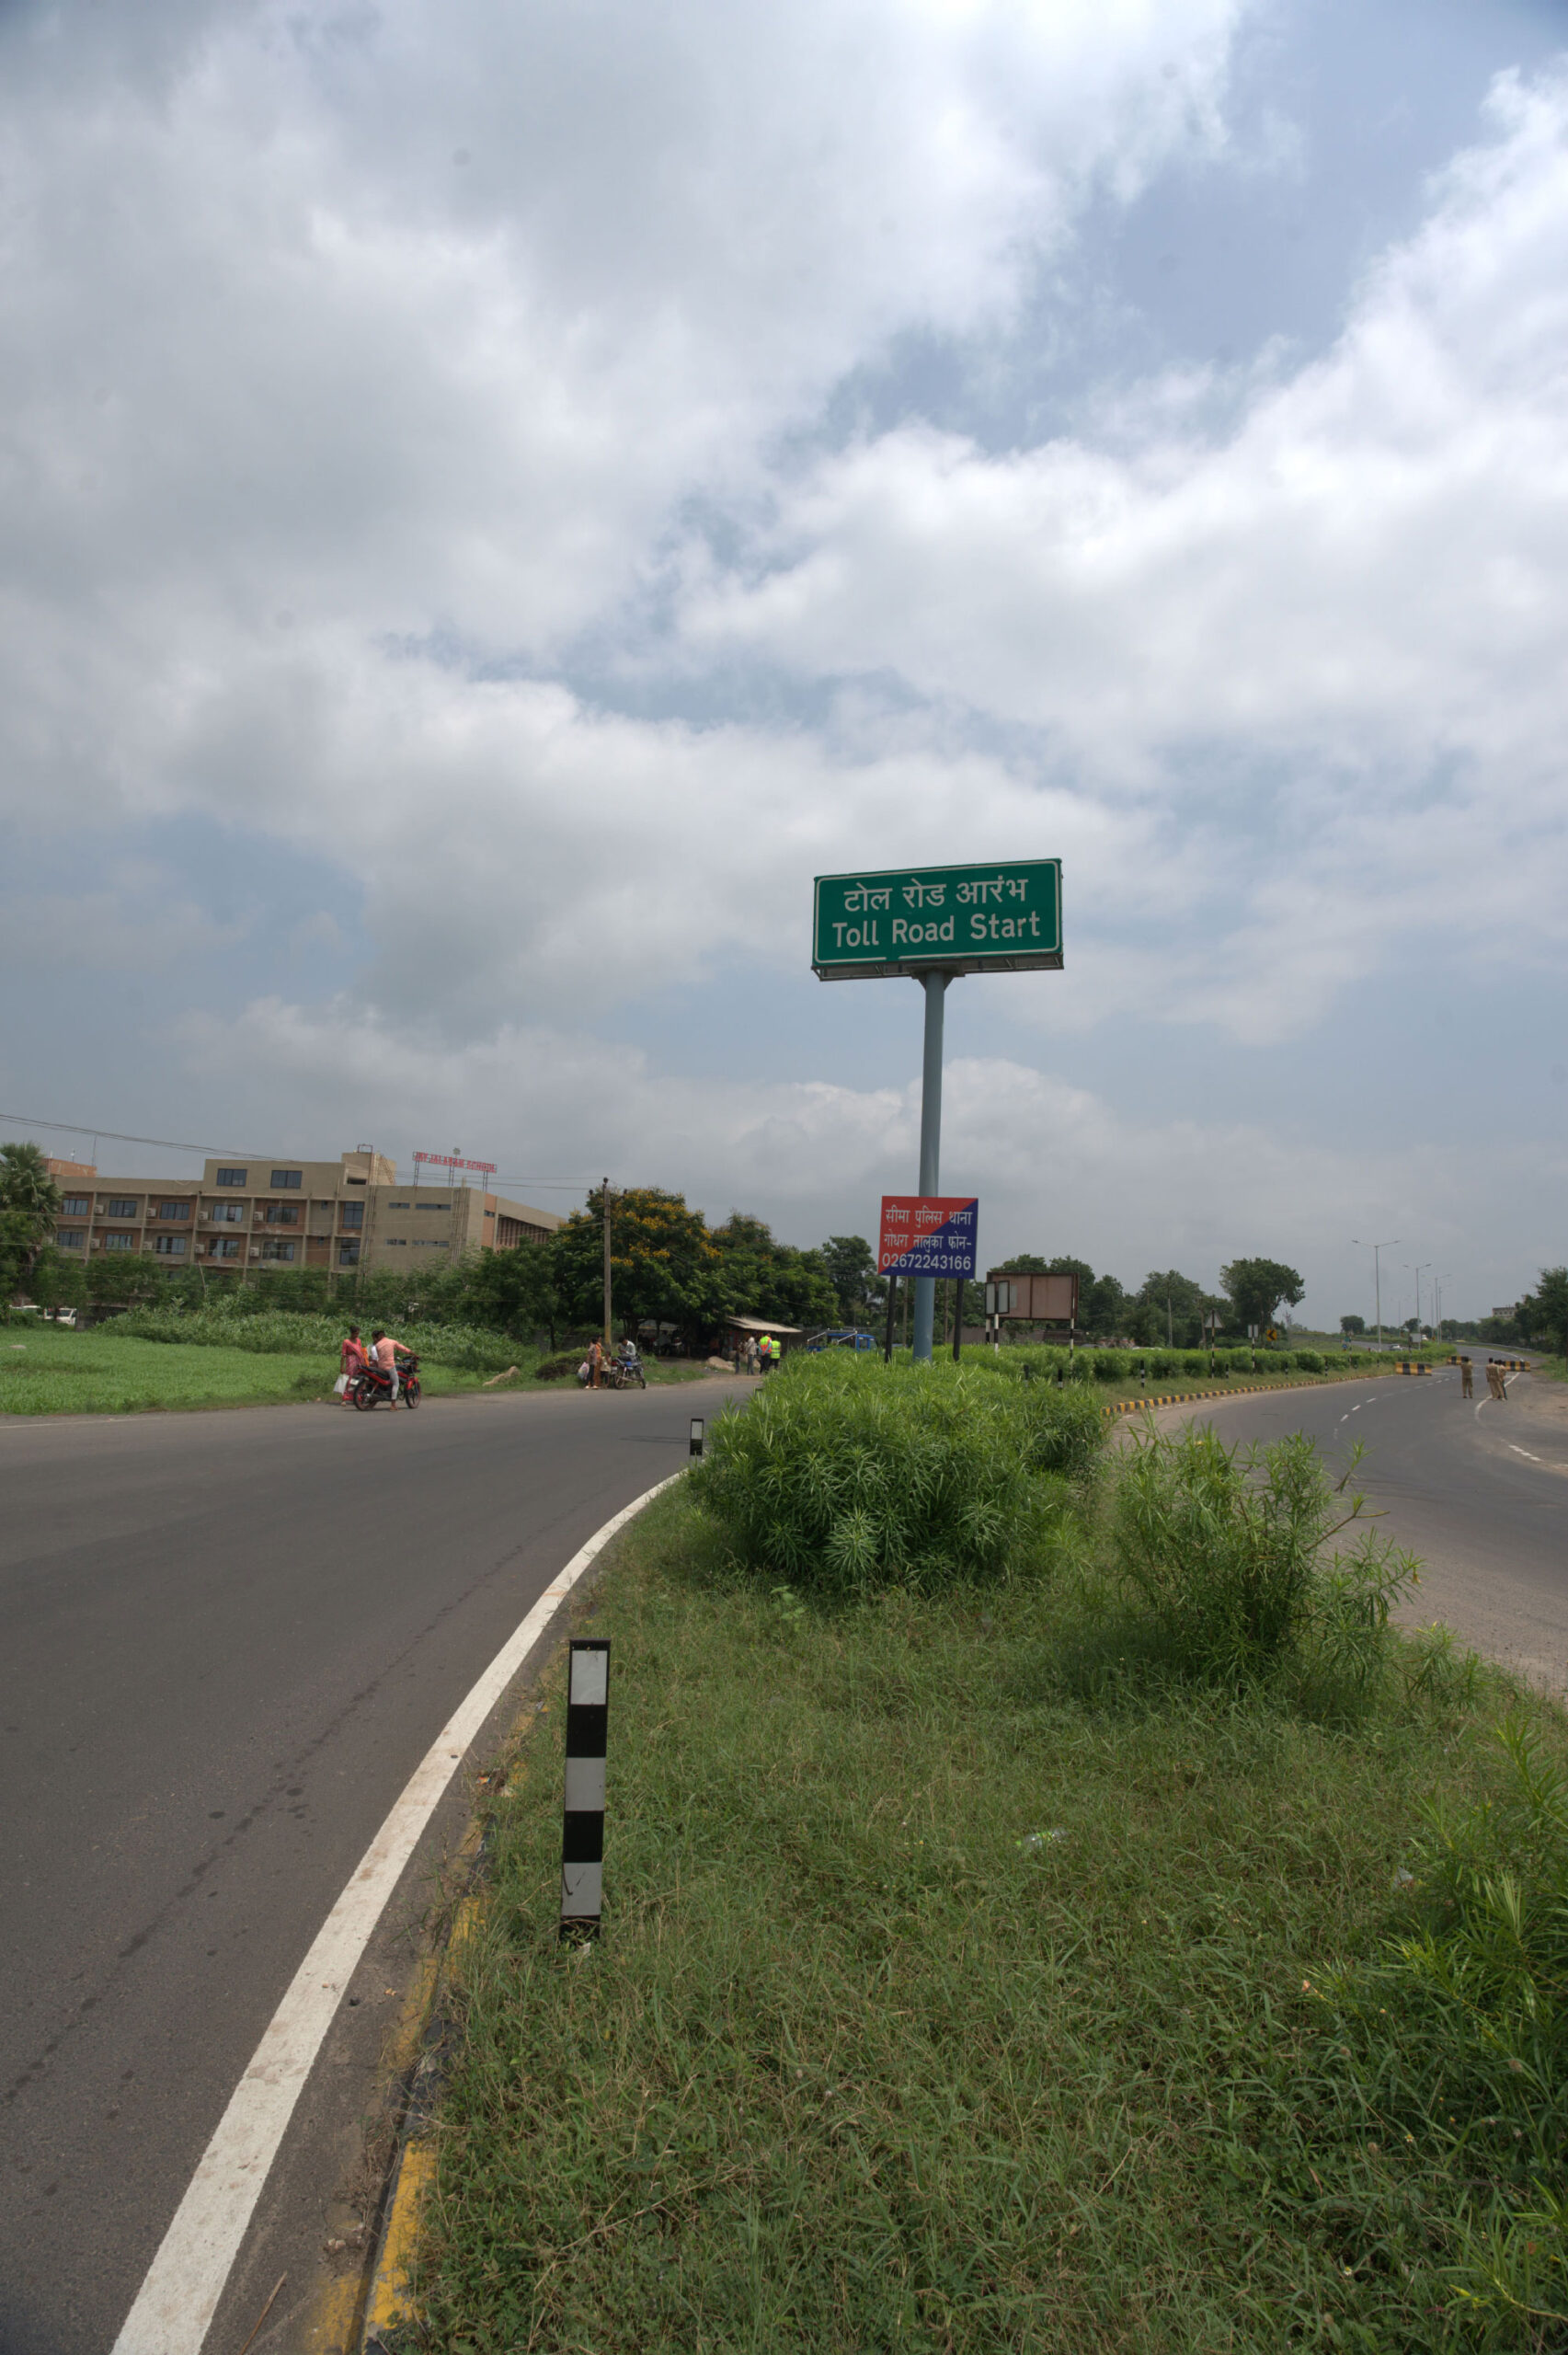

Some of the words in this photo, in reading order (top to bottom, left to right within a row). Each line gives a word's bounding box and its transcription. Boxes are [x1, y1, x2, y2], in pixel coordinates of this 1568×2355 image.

[844, 882, 893, 912] टोल
[902, 878, 946, 908] रोड
[956, 876, 1028, 904] आरंभ
[832, 920, 879, 948] Toll
[892, 915, 954, 945] Road
[970, 910, 1040, 940] Start
[467, 1160, 497, 1173] SCHOOL
[886, 1204, 910, 1223] सीमा
[915, 1206, 944, 1228] पुलिस
[949, 1212, 972, 1225] थाना
[884, 1229, 909, 1247] गोधरा
[913, 1235, 944, 1253] तालुका
[882, 1253, 971, 1270] 02672243166
